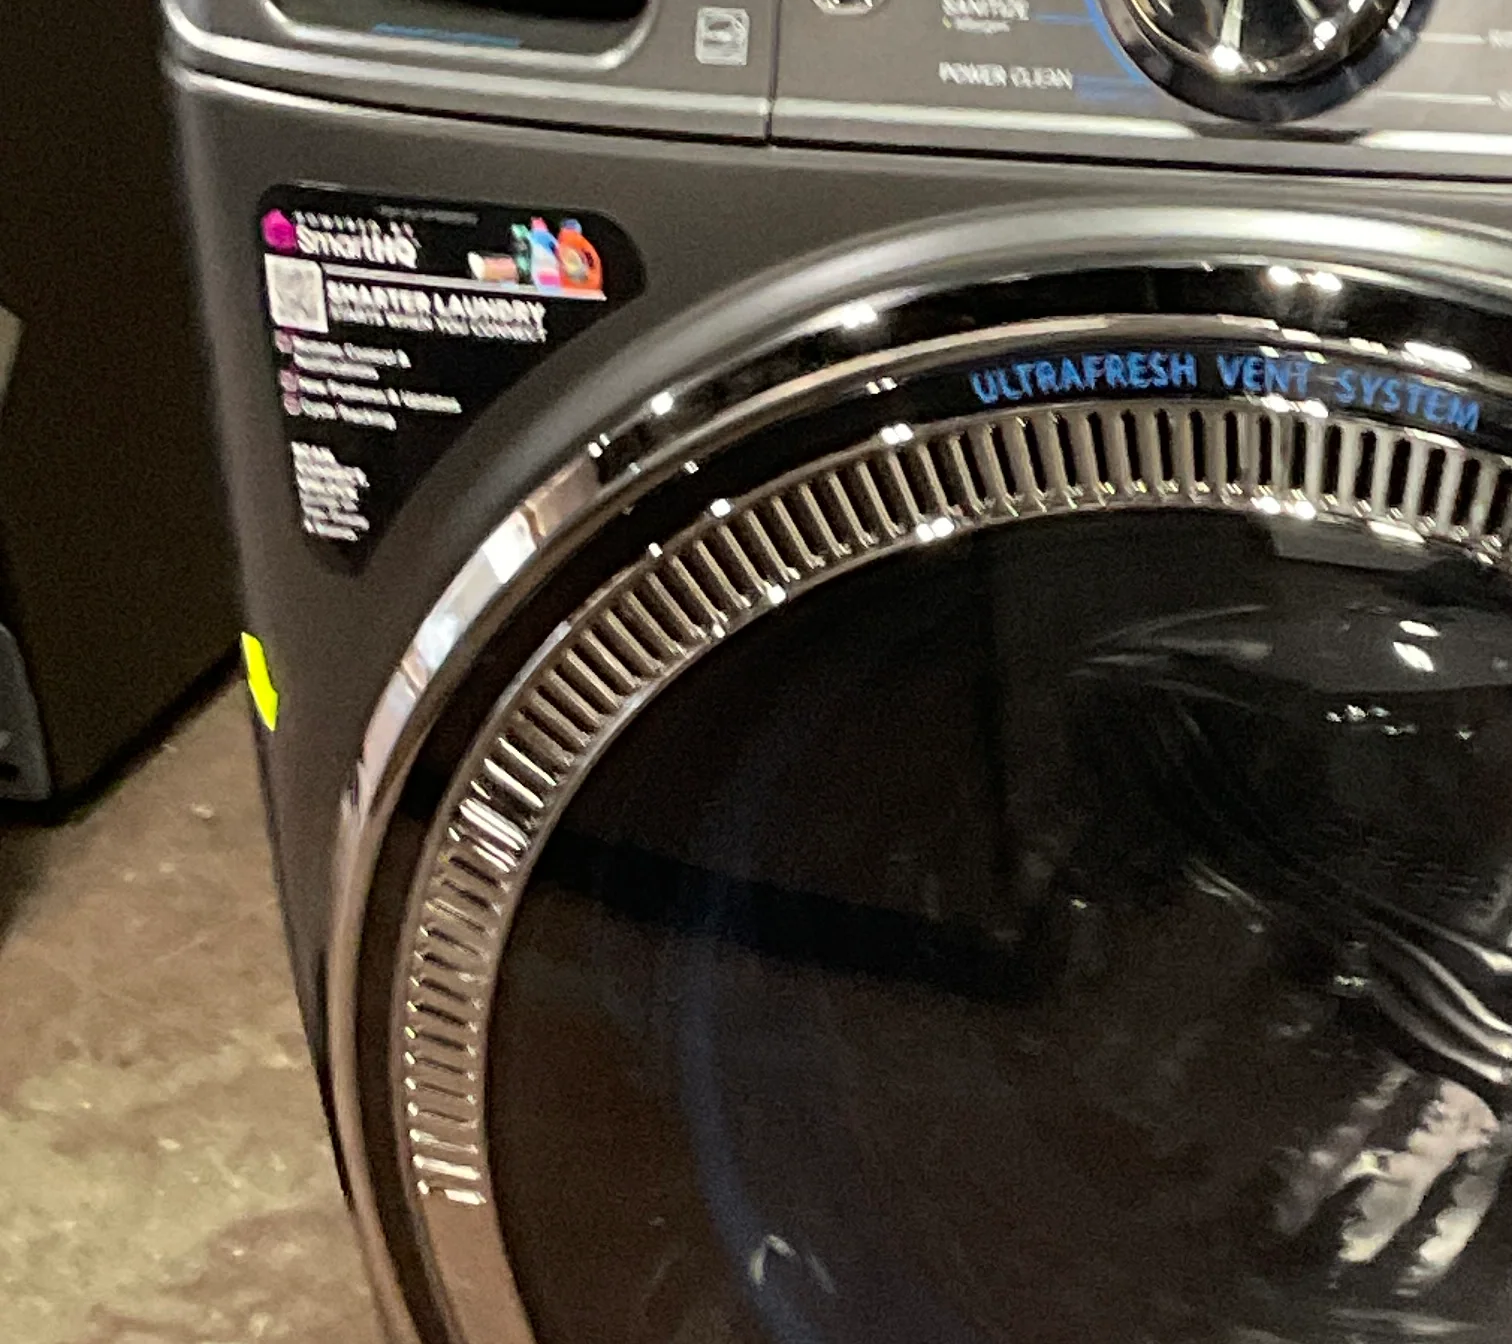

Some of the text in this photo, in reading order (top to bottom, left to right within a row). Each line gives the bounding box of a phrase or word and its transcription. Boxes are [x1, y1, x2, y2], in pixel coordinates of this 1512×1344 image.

[939, 62, 1073, 90] POWER CLEAN
[296, 224, 418, 269] SmartHQ
[326, 279, 433, 315] SMARTER
[969, 352, 1480, 432] ULTRAFRESH VENT SYSTEM
